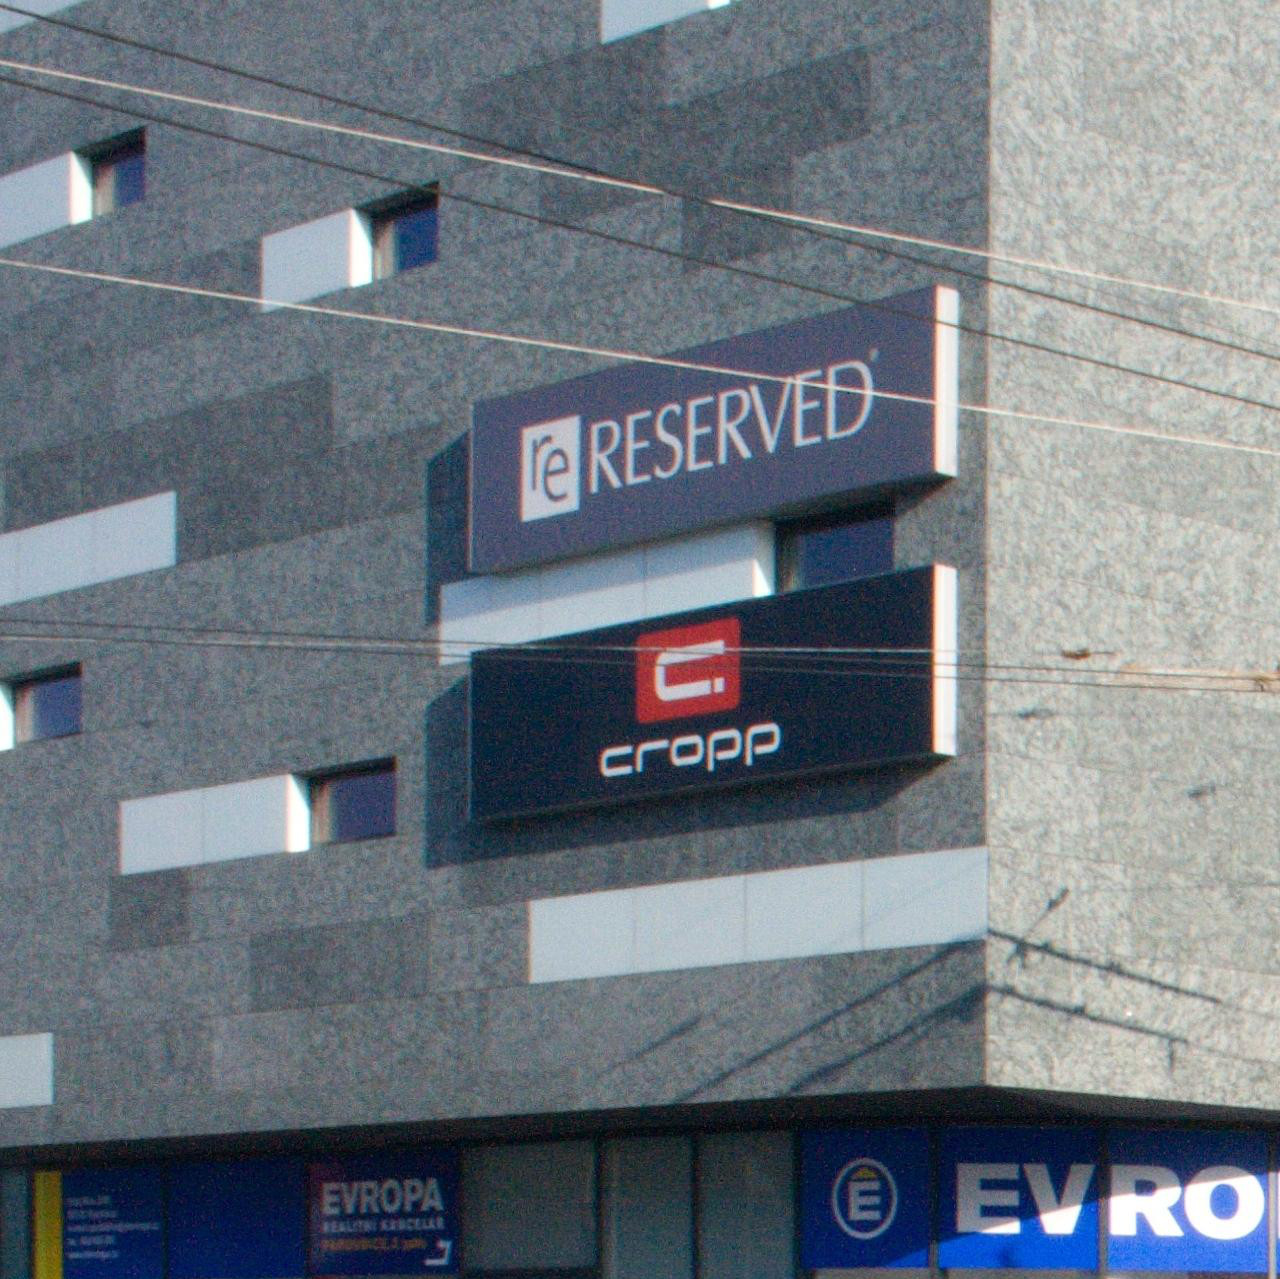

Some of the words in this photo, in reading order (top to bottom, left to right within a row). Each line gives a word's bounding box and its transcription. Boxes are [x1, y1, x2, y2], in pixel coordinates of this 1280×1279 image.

[588, 358, 874, 496] RESERVED
[599, 721, 781, 778] cropp
[321, 1177, 444, 1216] EVROPA
